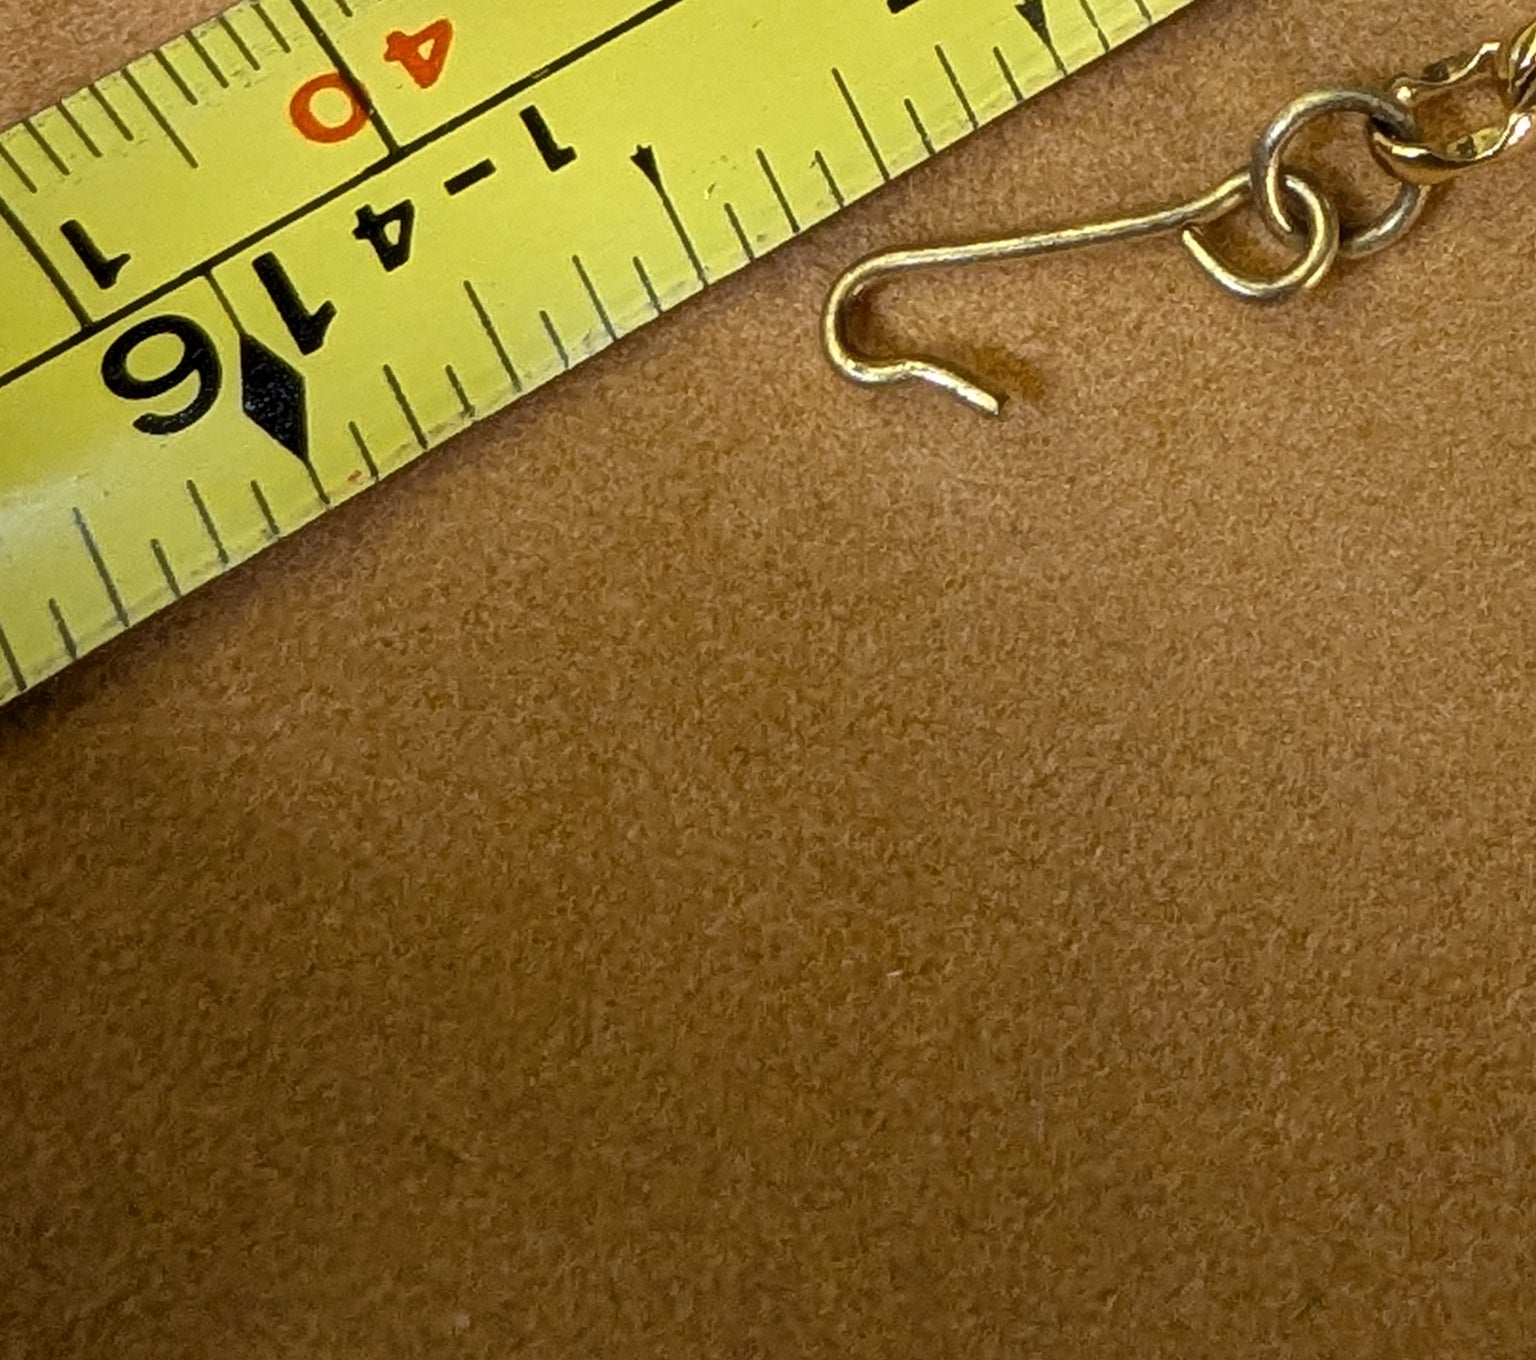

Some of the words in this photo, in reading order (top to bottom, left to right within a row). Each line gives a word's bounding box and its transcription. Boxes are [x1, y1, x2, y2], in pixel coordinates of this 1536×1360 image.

[288, 18, 454, 144] 40
[59, 220, 131, 290] 1
[100, 251, 337, 436] 16
